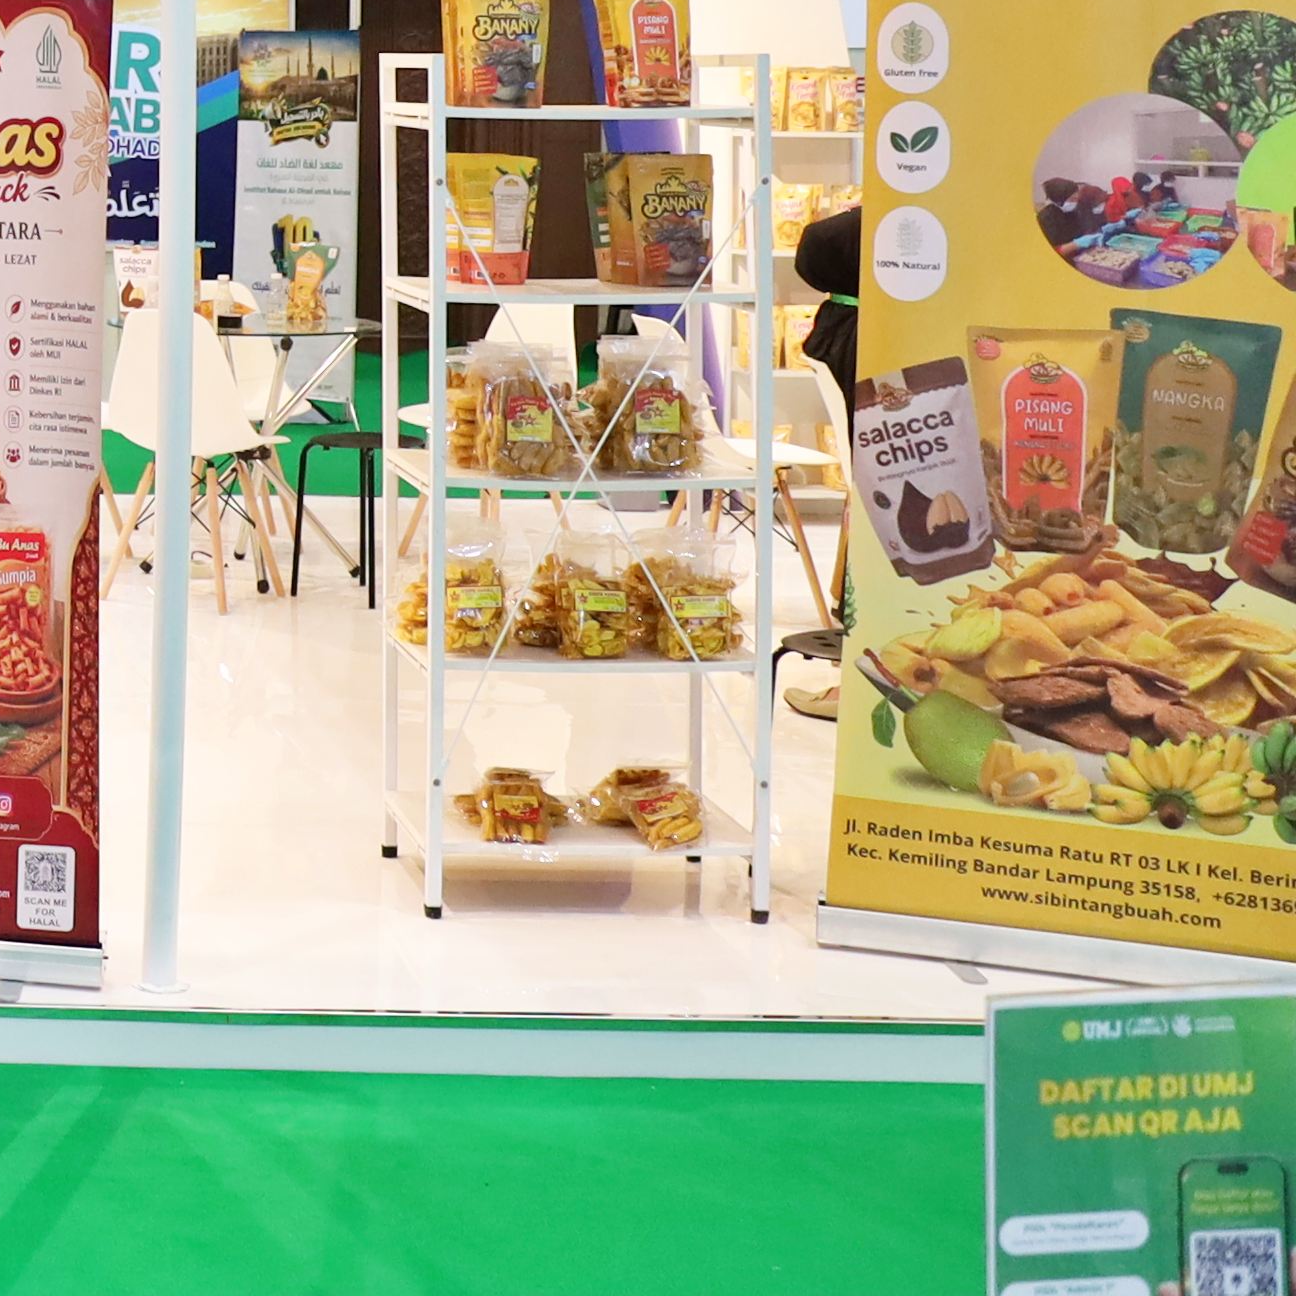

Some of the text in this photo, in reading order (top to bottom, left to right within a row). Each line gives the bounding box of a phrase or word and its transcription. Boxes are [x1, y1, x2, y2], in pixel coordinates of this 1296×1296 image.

[472, 15, 540, 42] BANANY
[884, 68, 939, 78] Gluten free
[896, 162, 927, 172] Vegan
[642, 192, 706, 219] BANANY
[4, 254, 37, 266] LEZAT
[876, 259, 941, 271] 100% Natural
[1015, 398, 1073, 415] PISANG
[1152, 388, 1226, 413] NANGKA
[858, 409, 955, 448] salacca
[875, 435, 949, 467] chips
[11, 538, 40, 551] Anas
[843, 818, 862, 835] Jl.
[866, 820, 924, 842] Raden
[928, 828, 975, 849] Imba
[979, 834, 1054, 859] Kesuma
[1060, 845, 1104, 865] Ratu
[1109, 851, 1134, 869] RT
[1137, 854, 1161, 872] 03
[1167, 858, 1191, 876] LK
[1208, 863, 1244, 882] Kel.
[846, 842, 1201, 903] Kec. Kemiling Bandar Lampung 35158,
[24, 896, 68, 908] SCAN ME
[35, 907, 56, 917] FOR
[981, 884, 1222, 930] www.sibintangbuah.com
[1082, 1019, 1122, 1039] UMJ
[1039, 1070, 1254, 1105] DAFTAR DI UMJ
[1053, 1107, 1242, 1140] SCAN QR AJA
